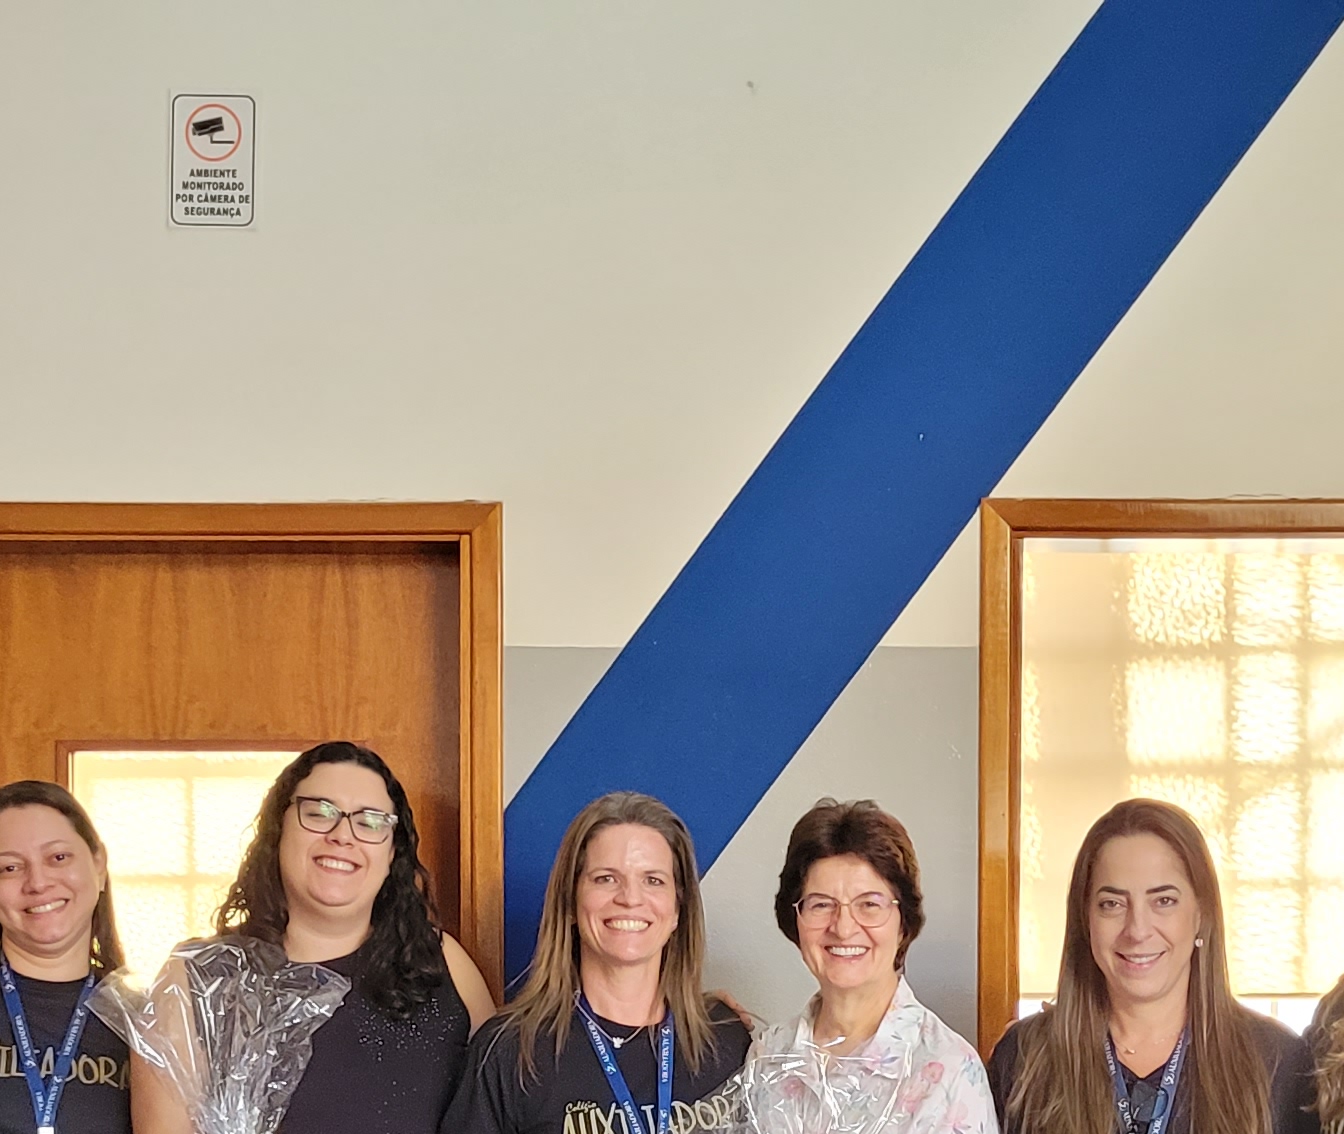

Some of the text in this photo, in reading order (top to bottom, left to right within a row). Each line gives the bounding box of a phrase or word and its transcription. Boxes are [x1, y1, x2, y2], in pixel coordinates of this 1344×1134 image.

[189, 168, 238, 179] AMBIENTE
[182, 181, 245, 191] MONITORADO
[175, 192, 250, 204] POR CÂMERA DE
[184, 206, 242, 218] SEGURANÇA
